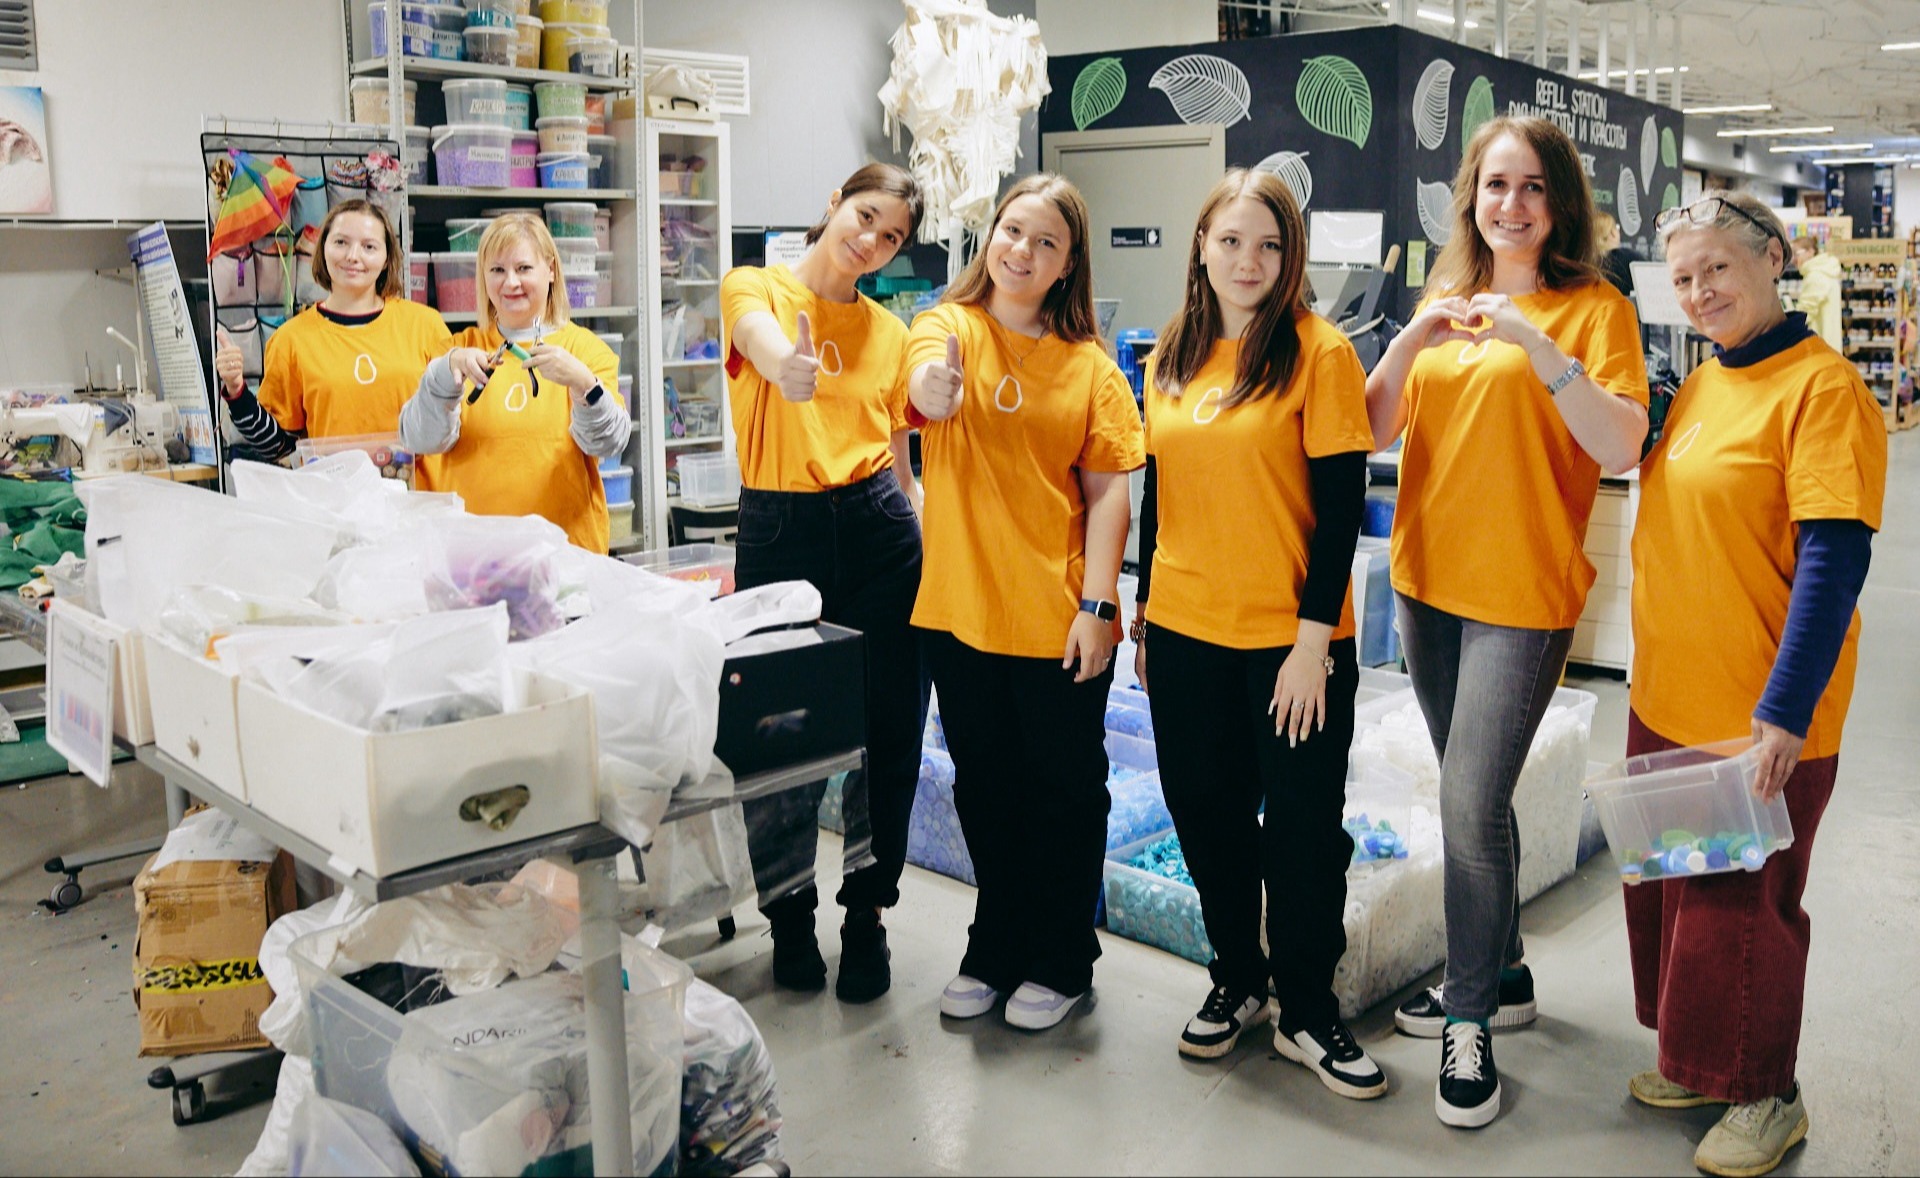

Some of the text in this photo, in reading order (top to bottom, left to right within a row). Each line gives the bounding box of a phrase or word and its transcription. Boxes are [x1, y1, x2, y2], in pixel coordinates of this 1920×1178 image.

[1536, 78, 1607, 121] REFILL STATION
[1578, 116, 1588, 143] И
[1589, 119, 1628, 150] КРАСОТЫ
